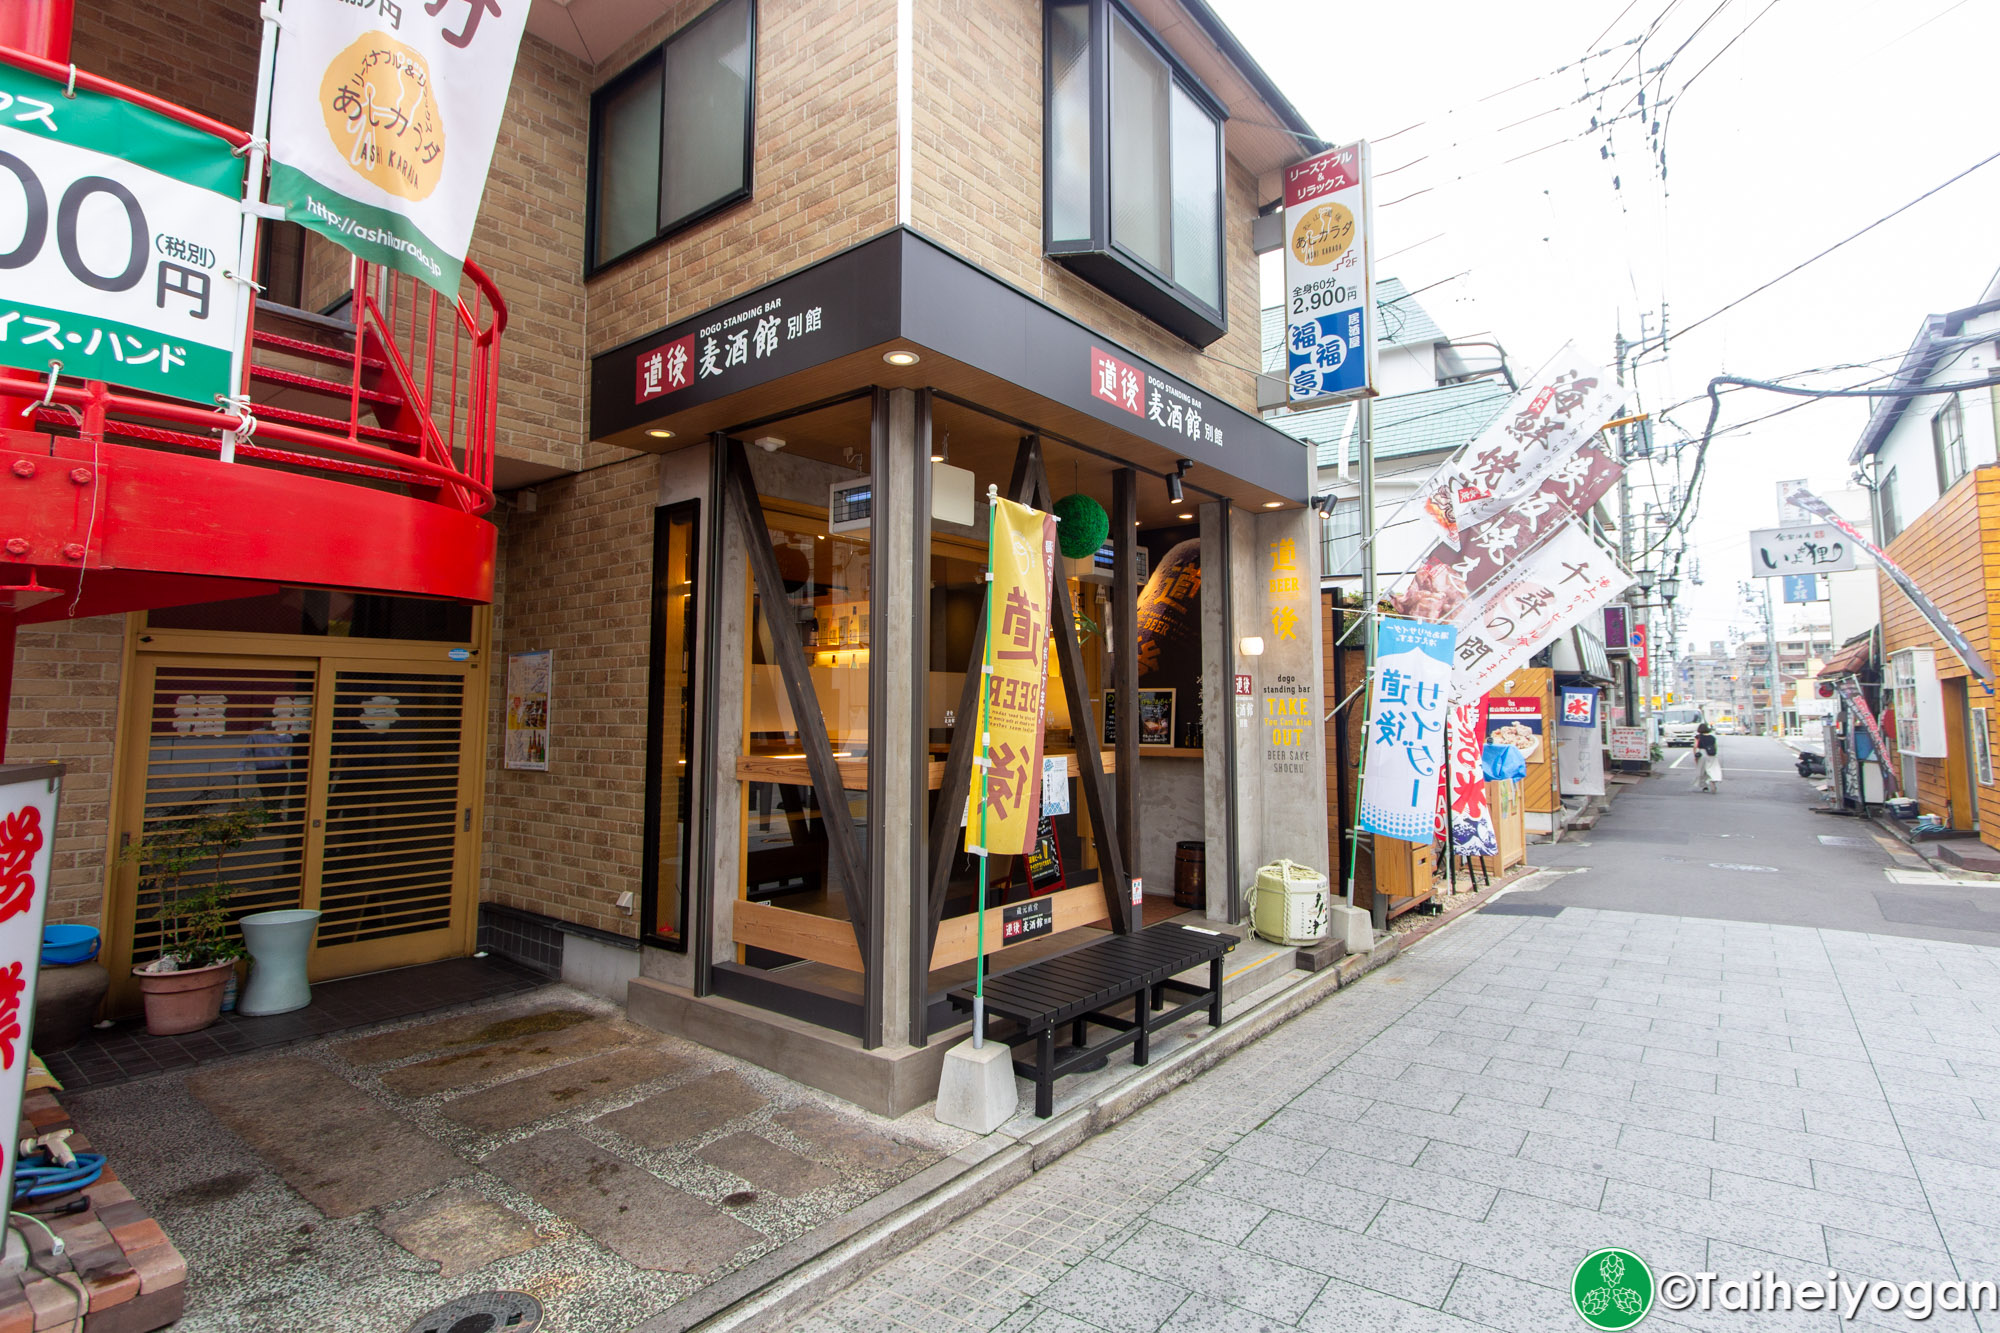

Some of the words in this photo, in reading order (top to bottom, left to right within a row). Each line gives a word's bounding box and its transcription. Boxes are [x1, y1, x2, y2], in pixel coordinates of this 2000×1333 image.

[1290, 150, 1353, 182] リーズナブル
[1317, 172, 1325, 181] &
[1297, 177, 1346, 200] リラックス
[1295, 220, 1352, 249] あしカラダ
[1345, 256, 1358, 268] 2F
[156, 260, 211, 320] 円
[1292, 277, 1337, 298] 全身60分
[1292, 285, 1346, 315] 2,900
[1347, 290, 1357, 301] 円
[700, 322, 722, 339] DOGO
[723, 306, 763, 329] STANDING
[764, 298, 782, 315] BAR
[1348, 312, 1361, 350] 居酒屋
[643, 342, 689, 398] 道後
[699, 315, 781, 380] 麦酒館
[786, 306, 823, 341] 別館
[1098, 358, 1140, 412] 道後
[1148, 387, 1202, 442] 麦酒館
[1204, 422, 1223, 447] 別館
[1148, 375, 1165, 391] DOGO
[1165, 384, 1191, 403] STANDING
[1191, 397, 1202, 410] BAR
[1269, 537, 1297, 572] 道
[1269, 576, 1300, 594] BEER
[1143, 617, 1170, 637] BEER
[1271, 605, 1299, 641] 後
[1263, 684, 1296, 696] standing
[1298, 683, 1311, 694] bar
[1277, 674, 1296, 687] dogo
[1266, 697, 1309, 716] TAKE
[1264, 717, 1277, 727] You
[1280, 717, 1294, 727] Can
[1296, 717, 1312, 727] Also
[1272, 729, 1304, 747] OUT
[1267, 750, 1287, 761] BEER
[1289, 750, 1310, 761] SAKE
[1273, 762, 1304, 774] SHOCHU
[1005, 921, 1020, 937] 道後
